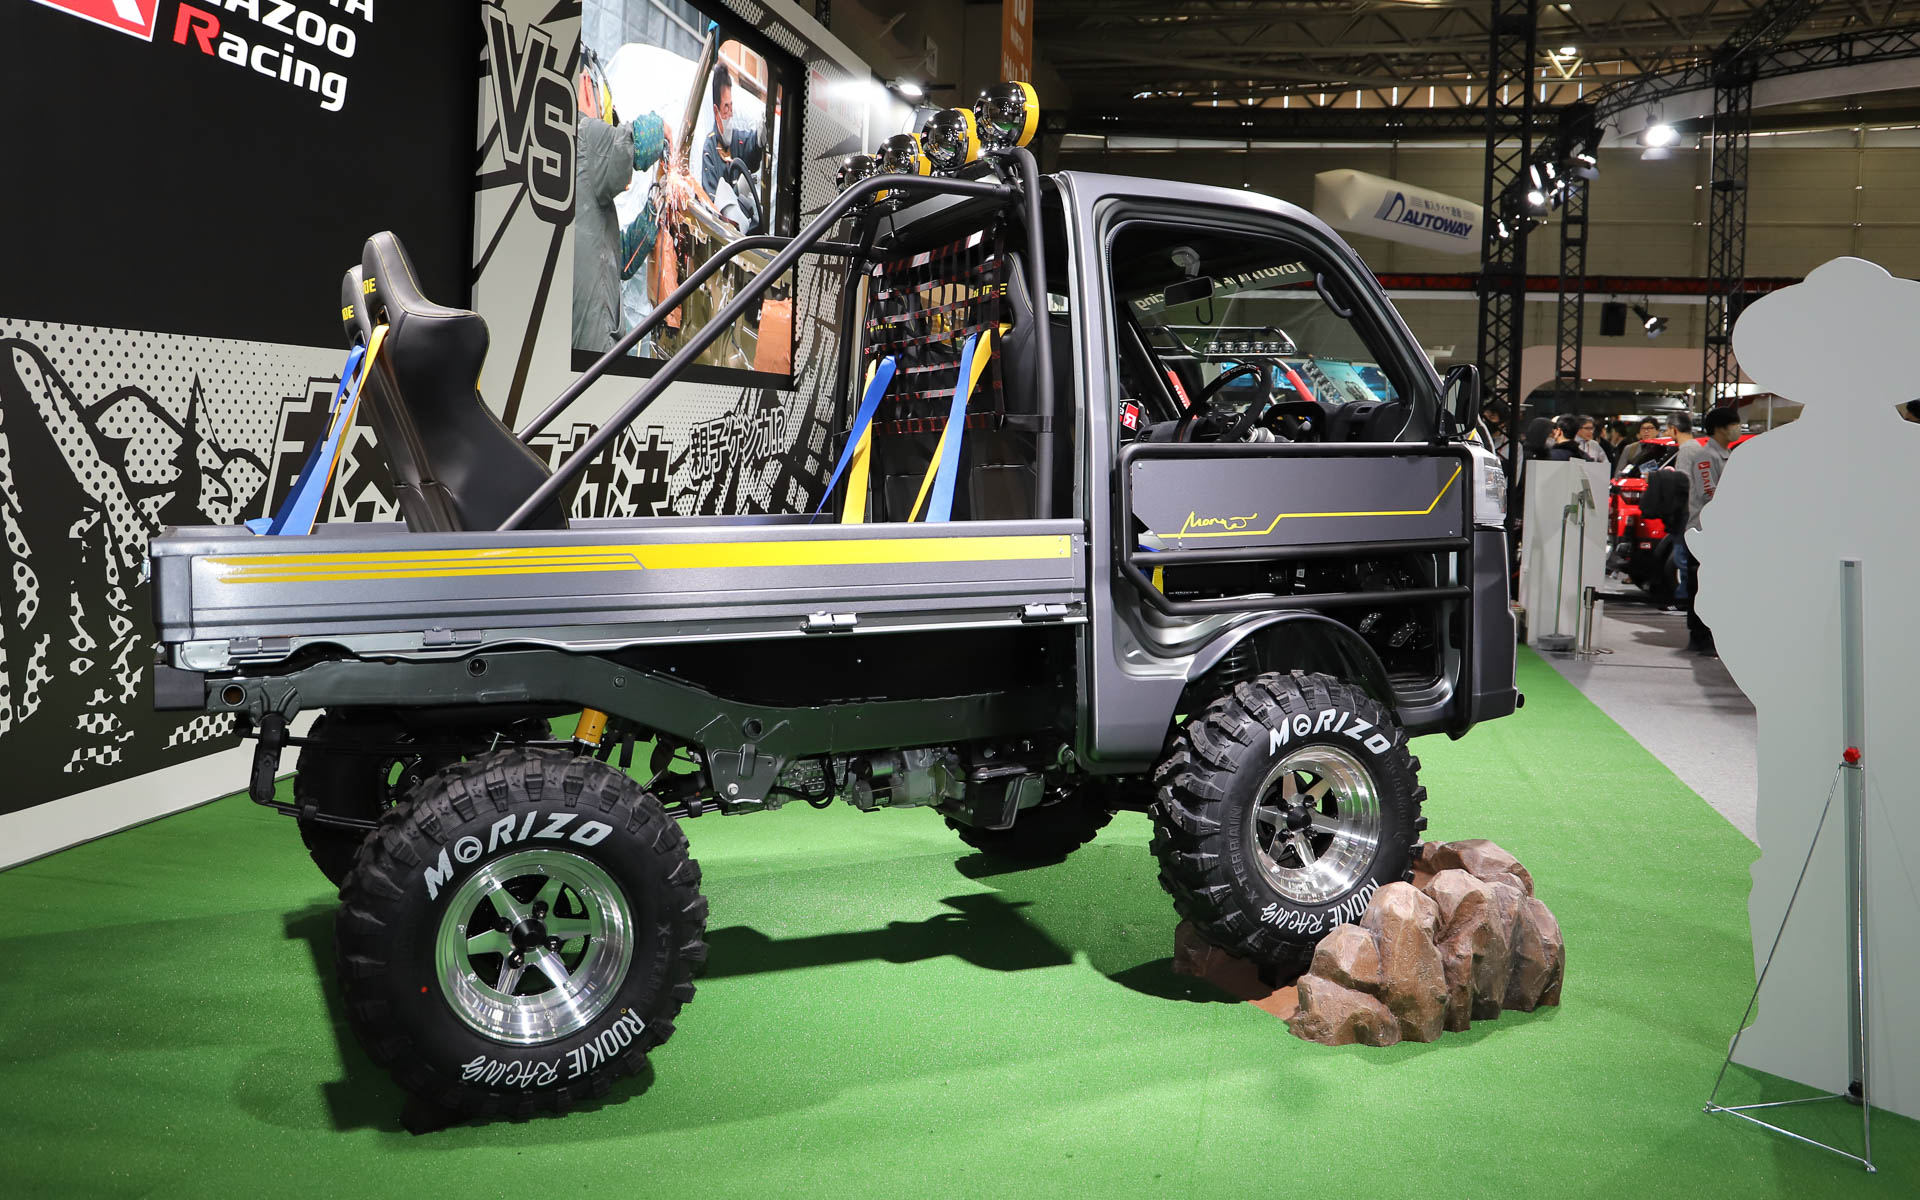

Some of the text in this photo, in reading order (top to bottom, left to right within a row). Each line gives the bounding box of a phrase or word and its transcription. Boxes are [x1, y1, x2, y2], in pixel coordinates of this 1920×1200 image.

[172, 2, 348, 112] Racing
[203, 0, 356, 58] AZOO
[488, 8, 576, 210] VS
[1402, 211, 1473, 237] AUTOWAY
[1269, 708, 1391, 757] MORIZO
[424, 810, 613, 901] MORIZO
[1260, 902, 1325, 935] RACING
[461, 1007, 646, 1088] ROOKIE RACING
